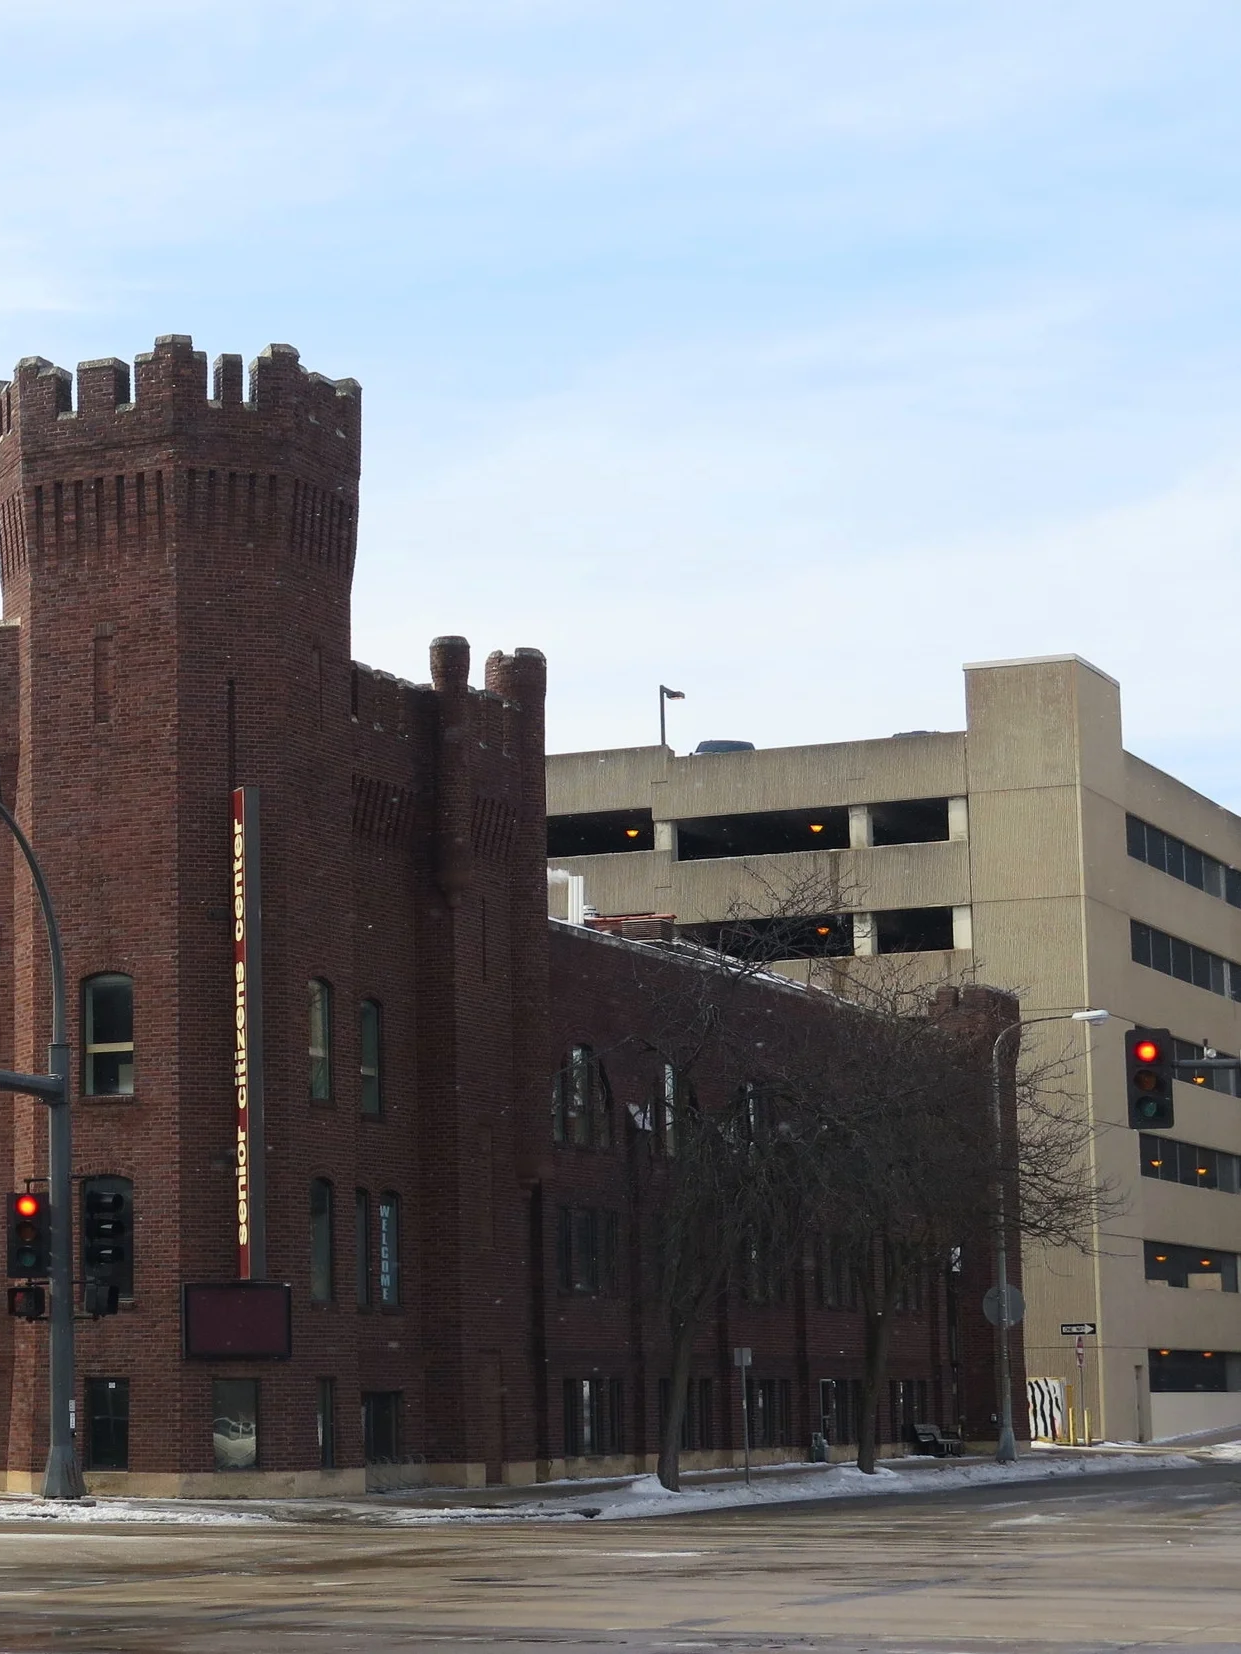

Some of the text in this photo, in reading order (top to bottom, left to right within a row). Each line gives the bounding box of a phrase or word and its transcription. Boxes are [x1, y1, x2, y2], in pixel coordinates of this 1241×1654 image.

[232, 818, 248, 1246] senior citizens center
[380, 1205, 390, 1300] WELCOME
